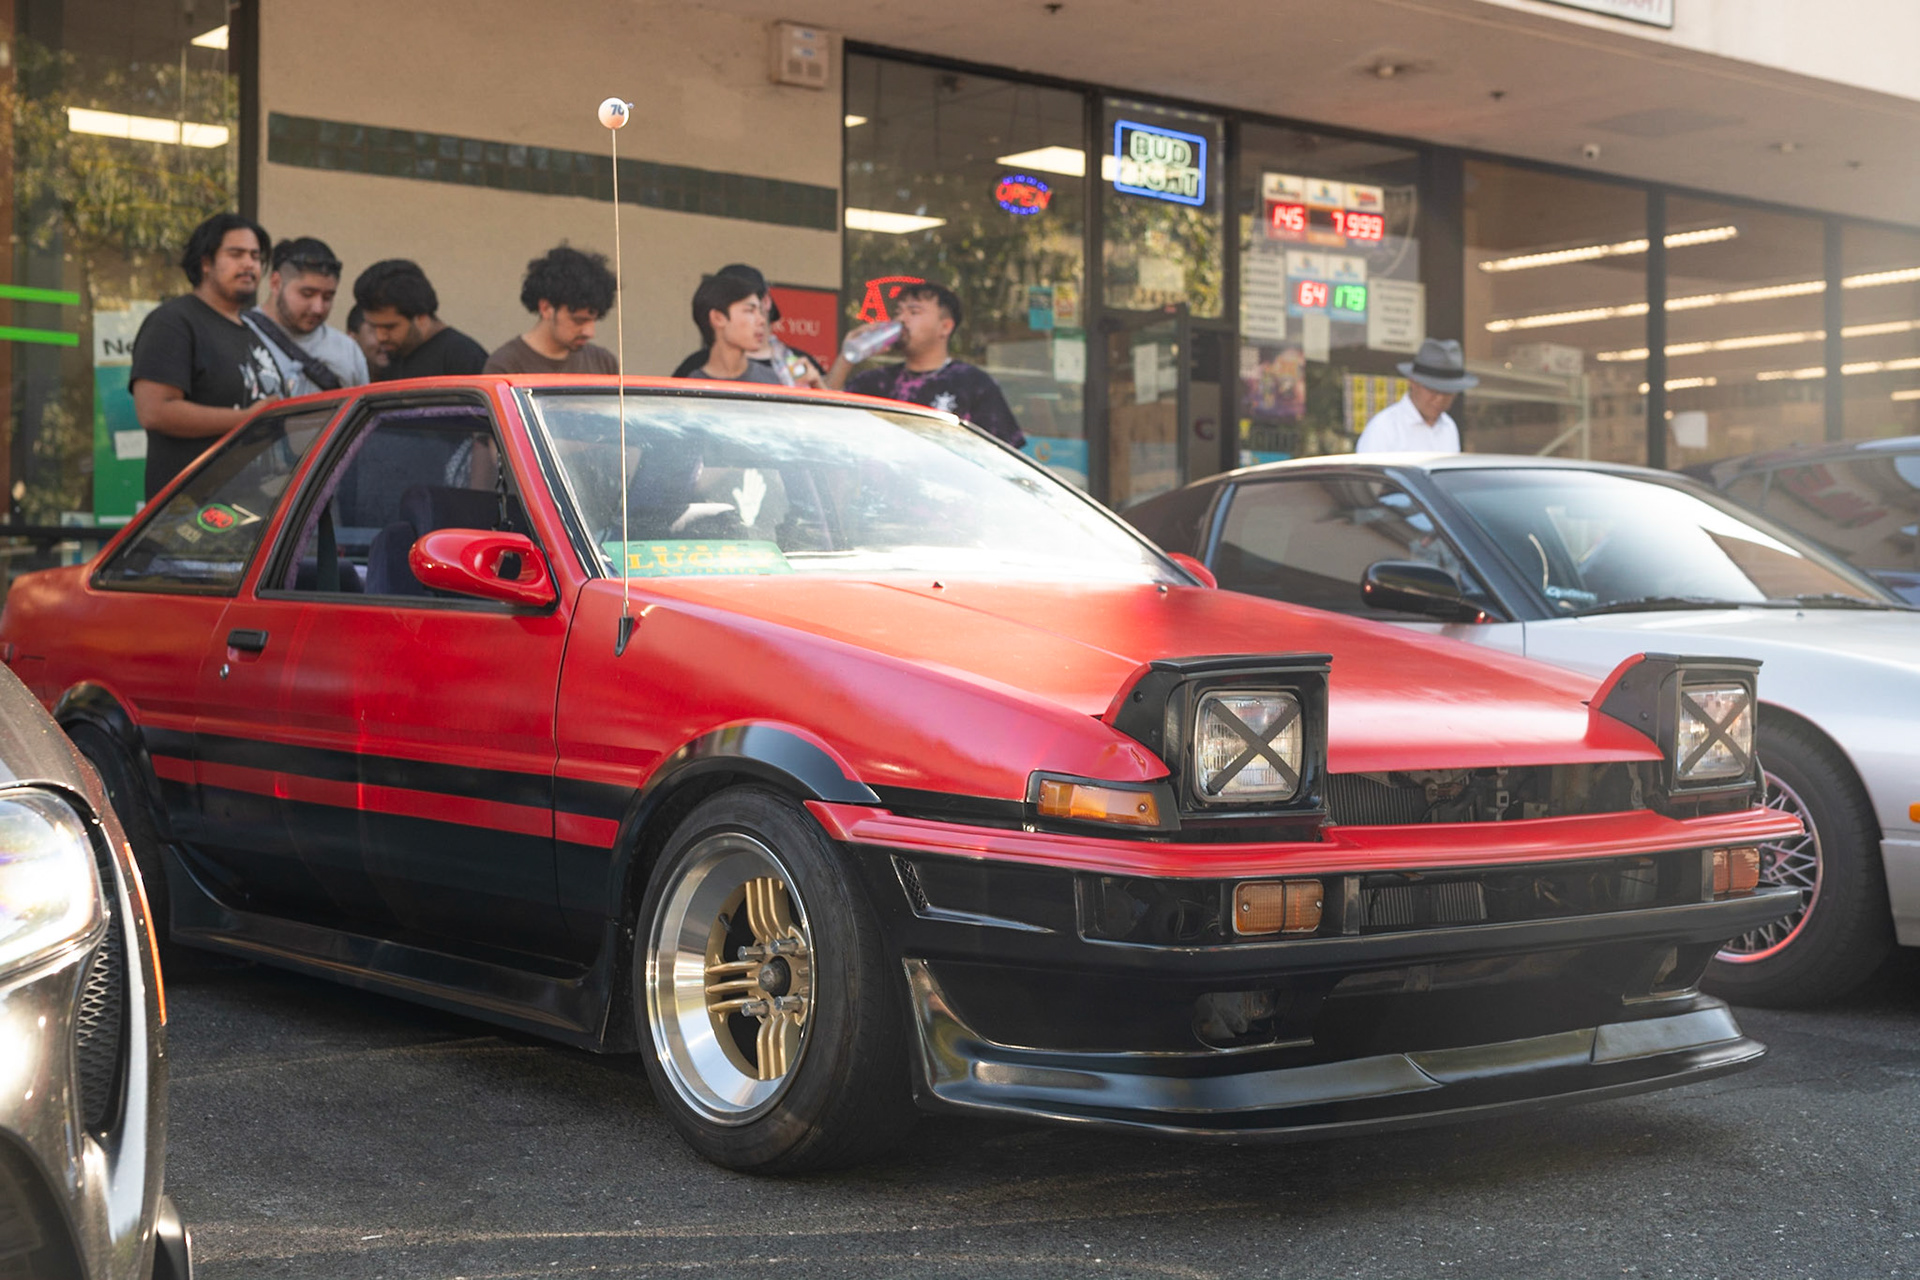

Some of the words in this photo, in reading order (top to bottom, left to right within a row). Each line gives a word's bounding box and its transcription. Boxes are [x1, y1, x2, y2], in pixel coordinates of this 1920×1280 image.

[611, 104, 624, 116] 76
[1130, 130, 1192, 167] BUD
[996, 183, 1052, 209] OPEN
[1273, 204, 1306, 232] 145
[1299, 280, 1328, 307] 64
[788, 318, 820, 337] YOU
